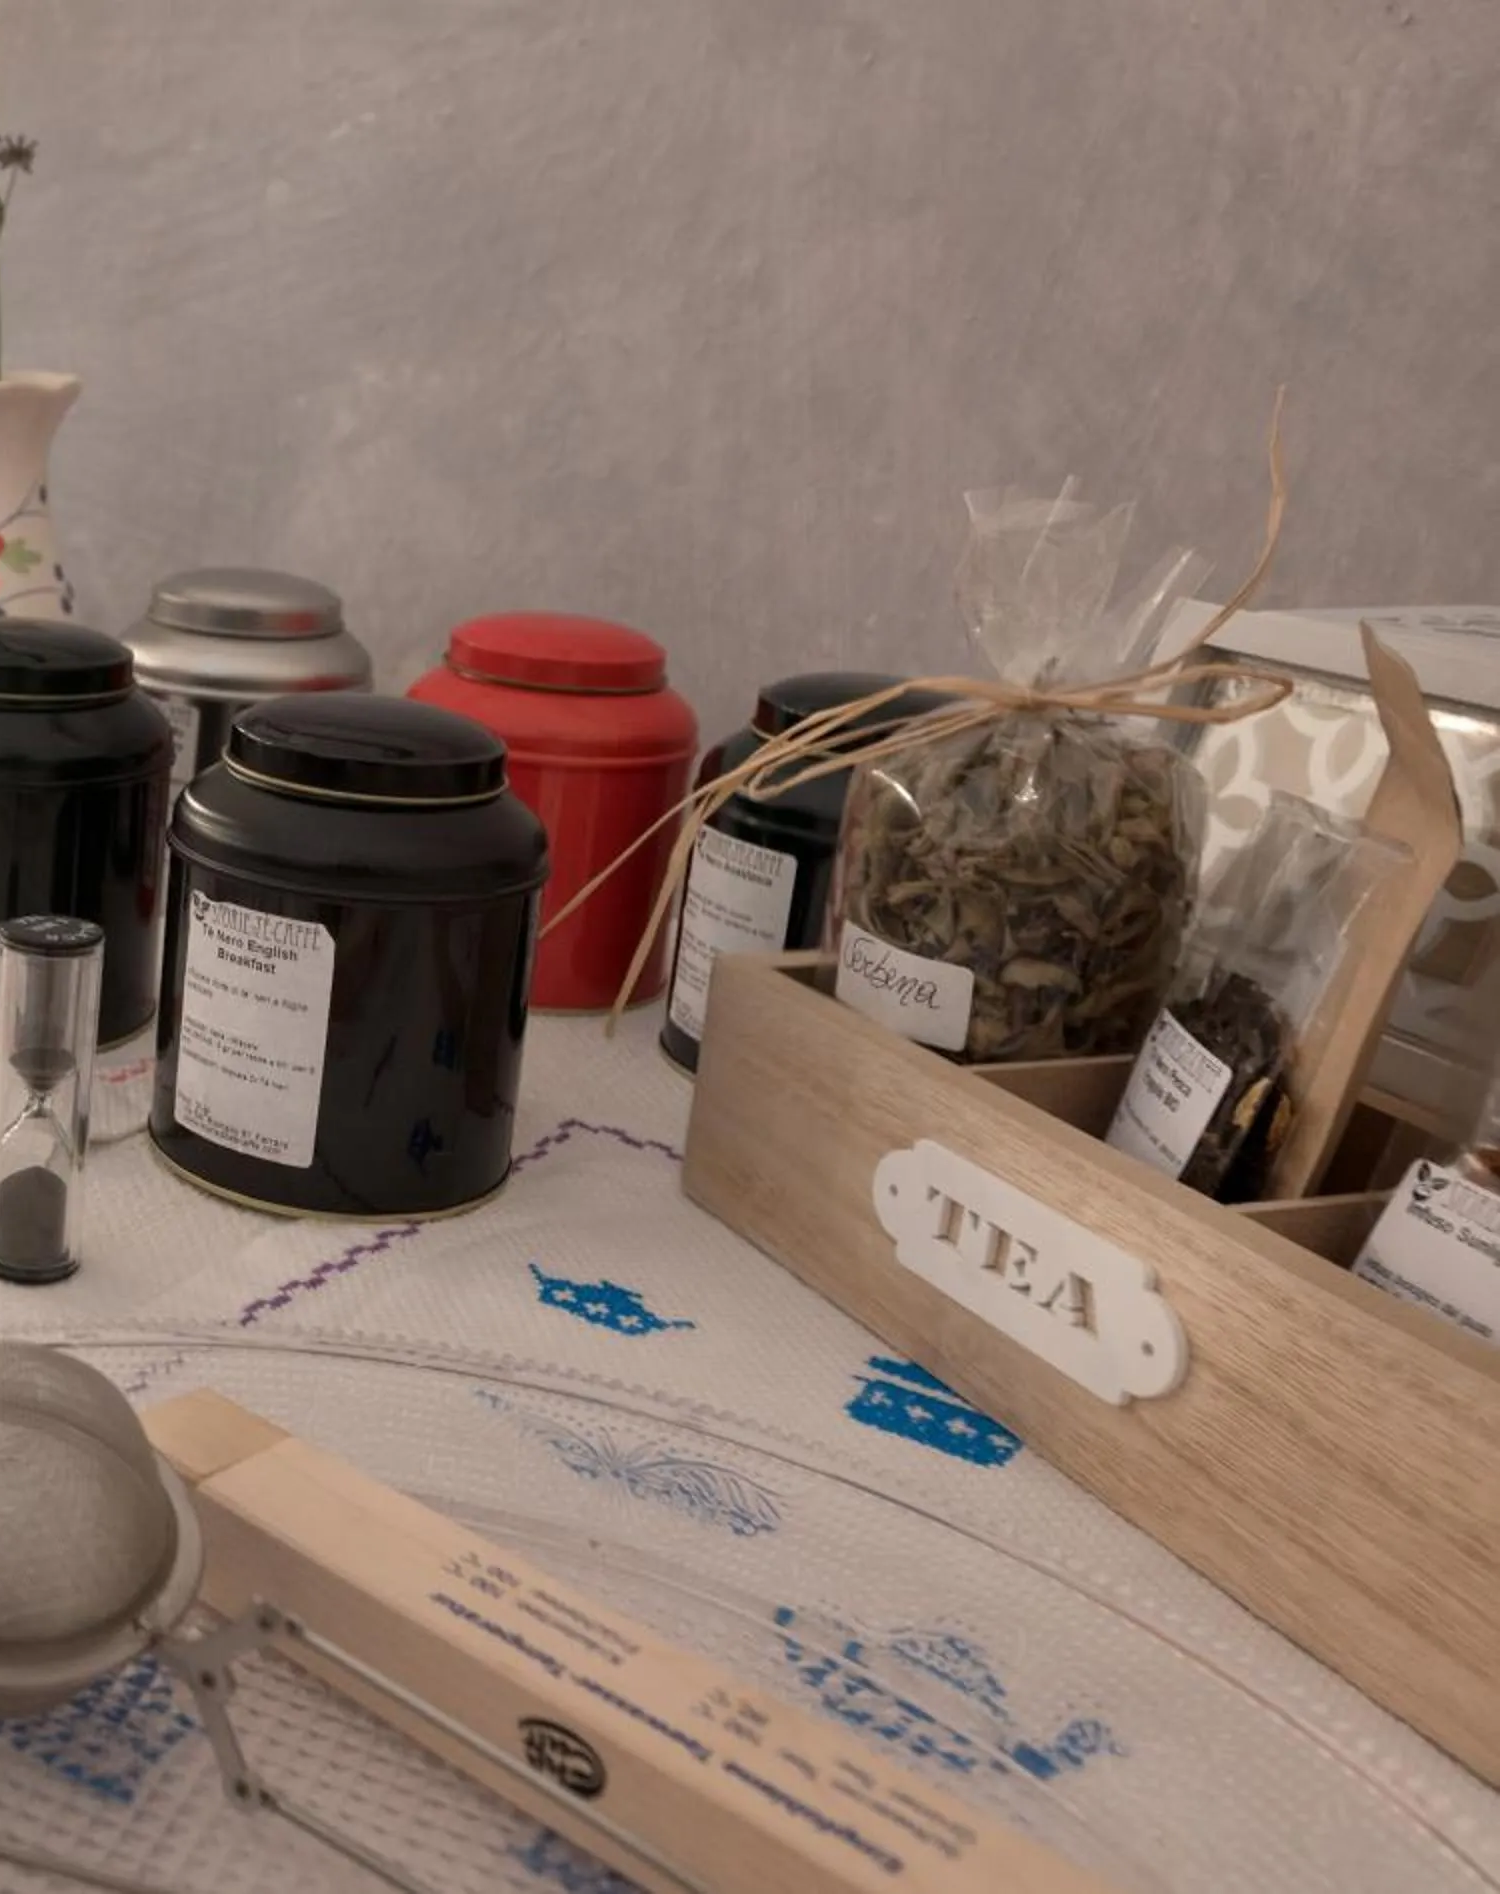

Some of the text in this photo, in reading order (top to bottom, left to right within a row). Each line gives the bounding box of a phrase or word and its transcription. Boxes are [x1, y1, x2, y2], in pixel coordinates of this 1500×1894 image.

[216, 929, 245, 949] Nero
[247, 939, 299, 962] English
[217, 947, 277, 975] Breakfast
[925, 1183, 1099, 1340] TEA
